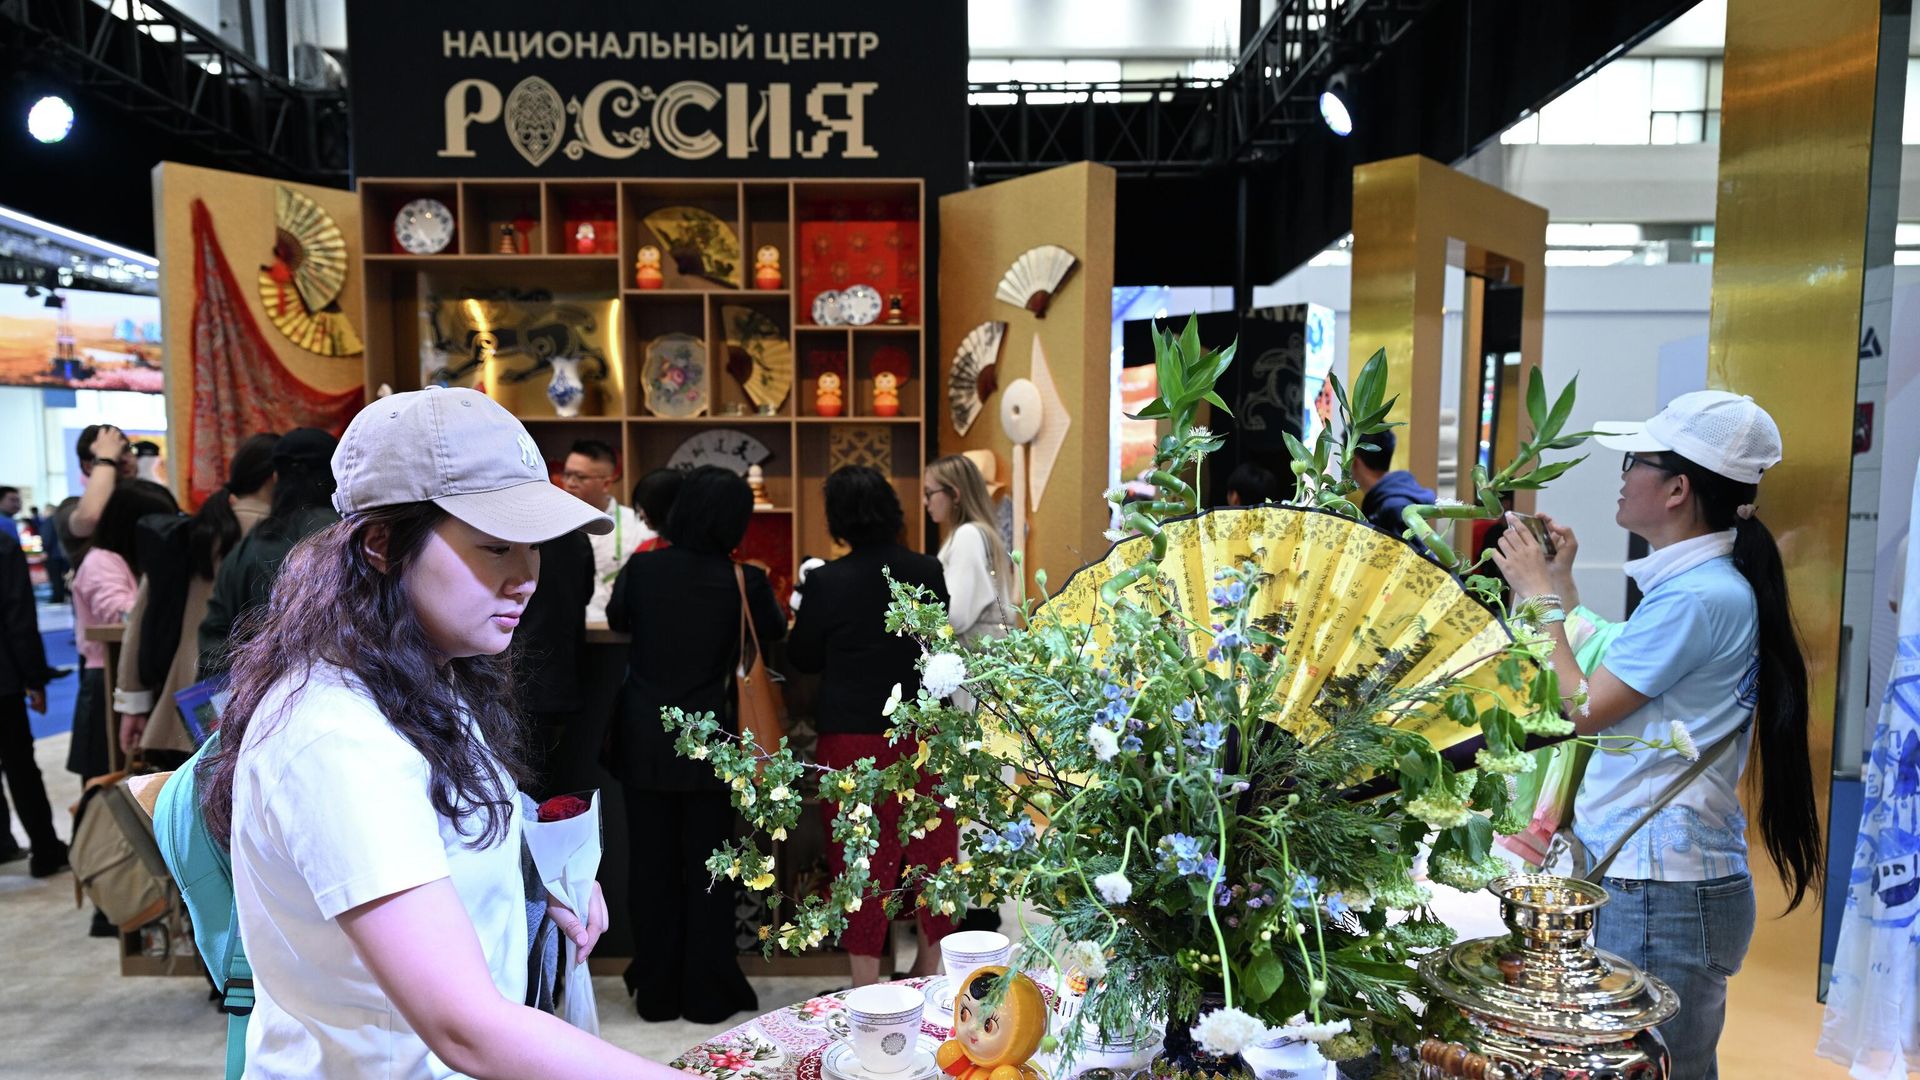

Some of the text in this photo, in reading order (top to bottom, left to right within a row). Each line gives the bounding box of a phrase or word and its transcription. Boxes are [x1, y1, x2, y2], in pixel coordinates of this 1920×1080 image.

[442, 25, 880, 65] НАЦИОНАЛЬНЫЙ ЦЕНТР
[437, 75, 880, 168] РОССИЯ
